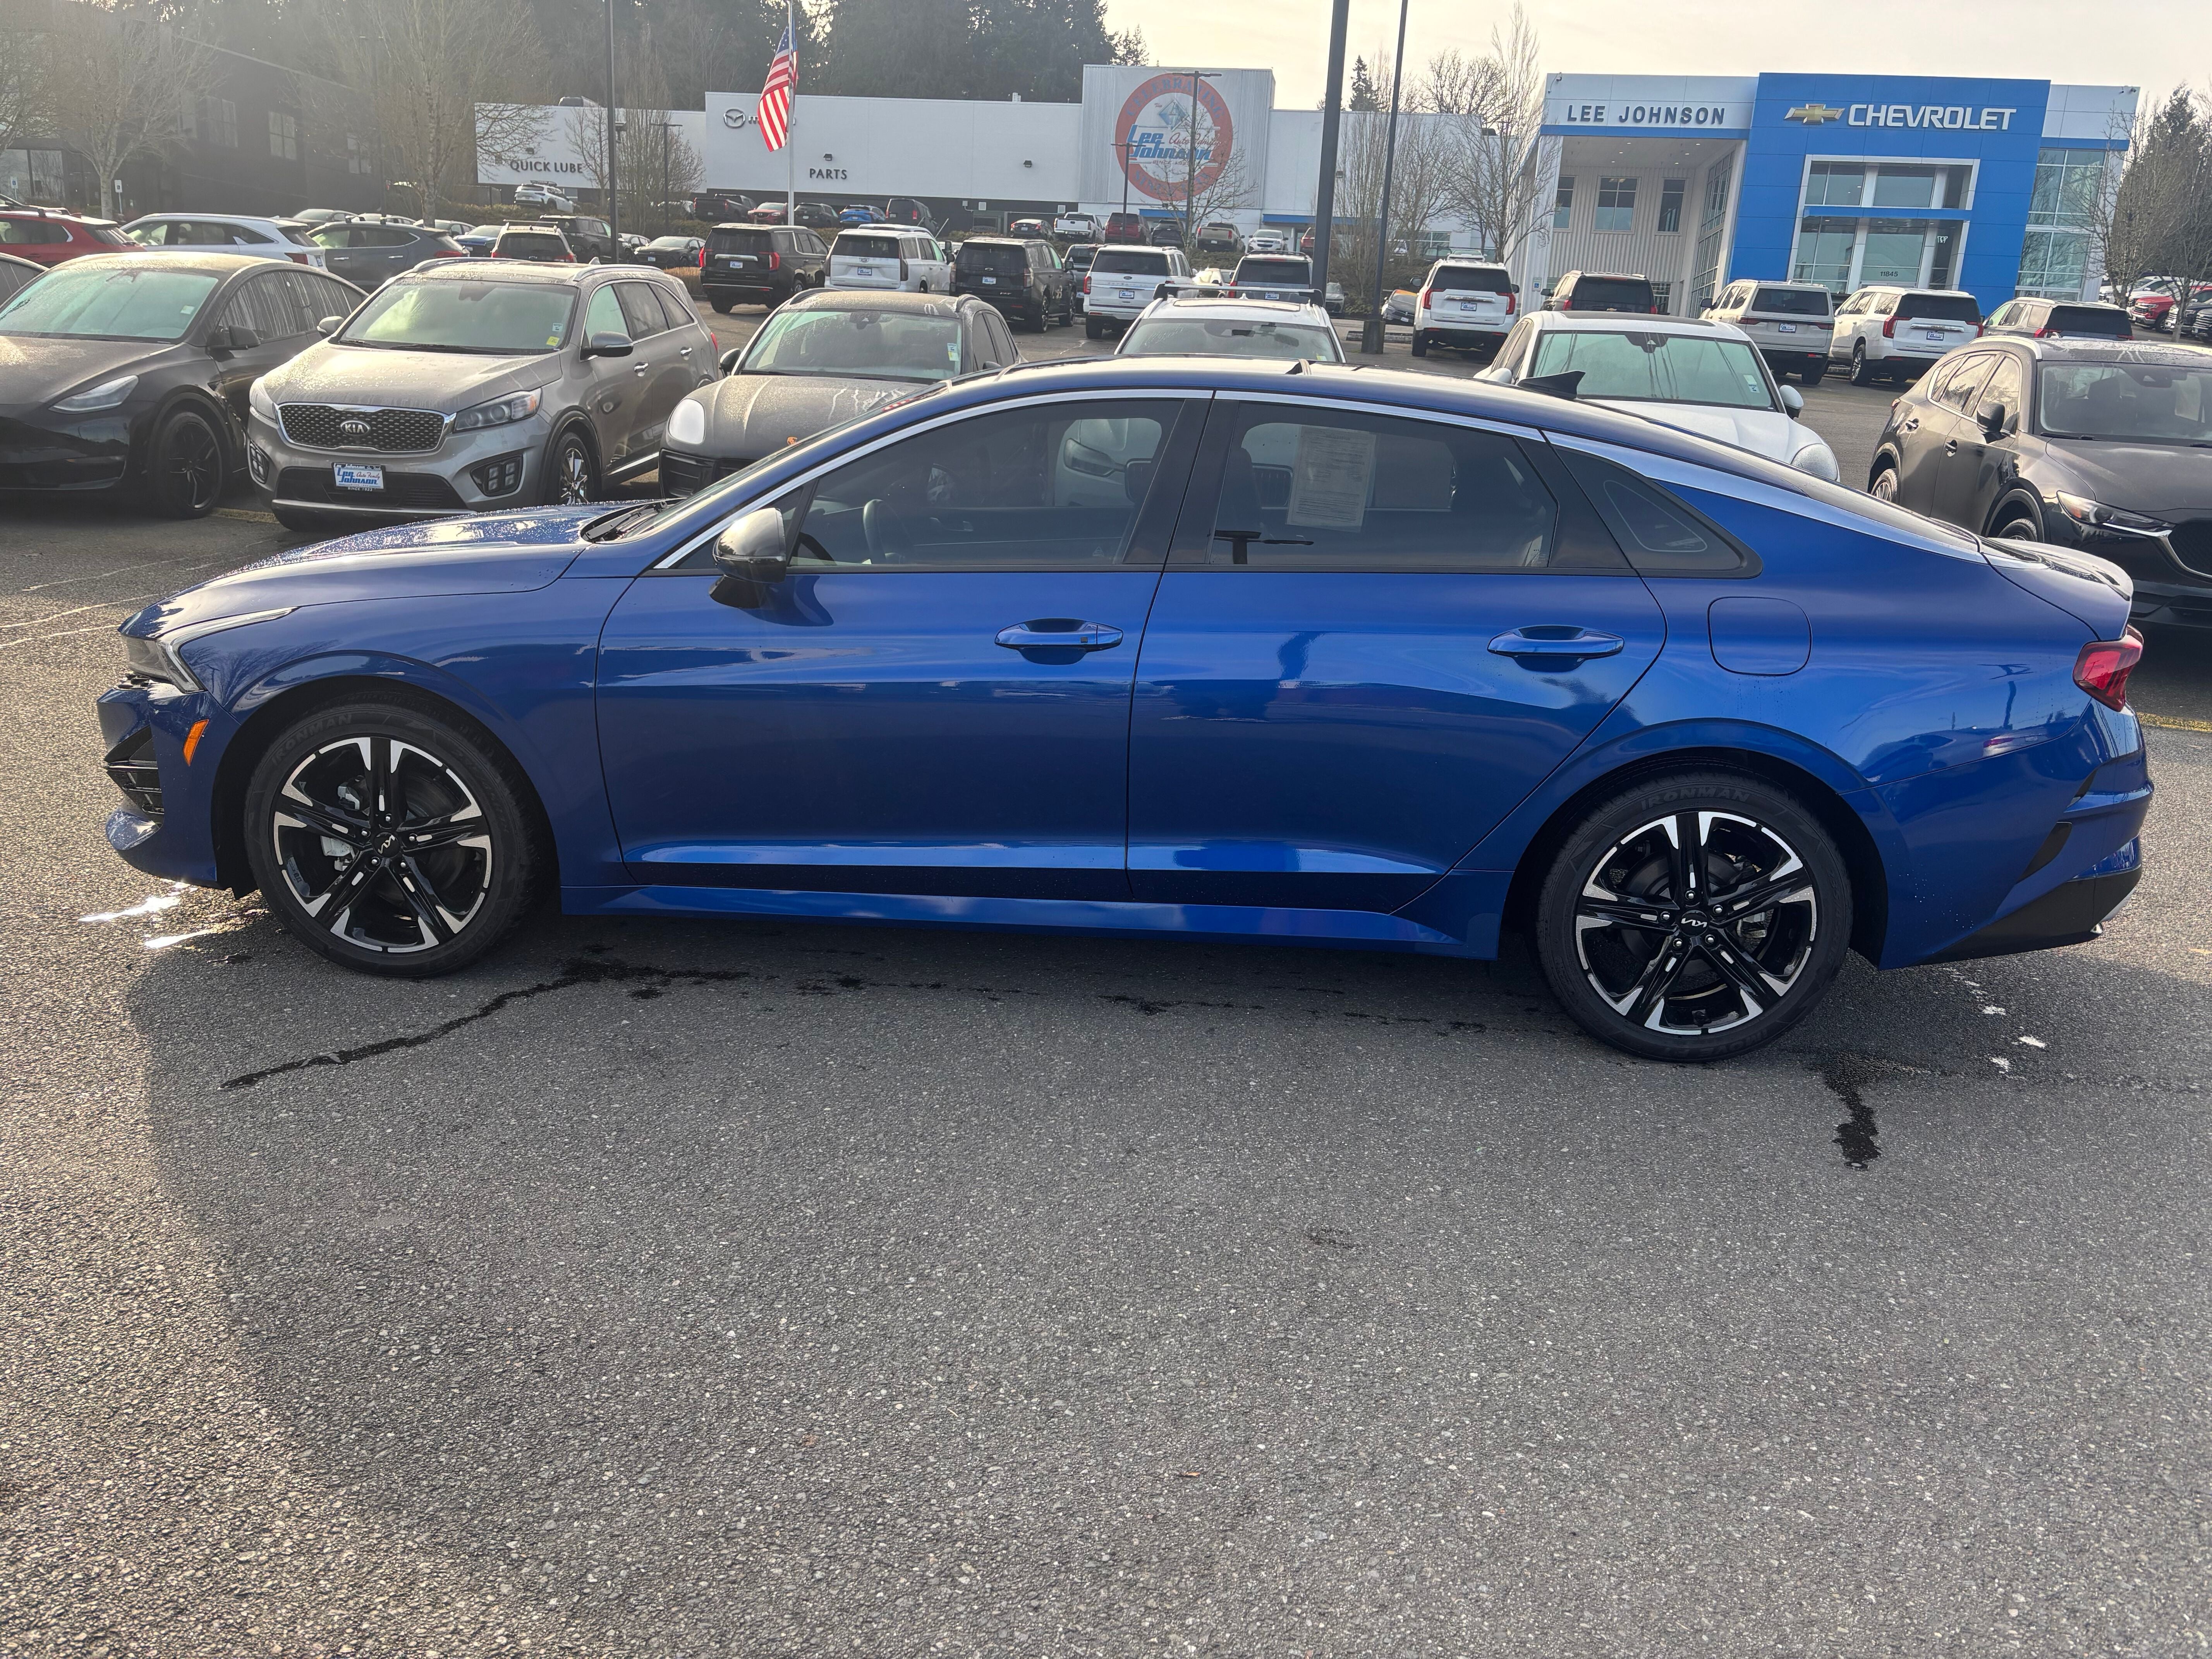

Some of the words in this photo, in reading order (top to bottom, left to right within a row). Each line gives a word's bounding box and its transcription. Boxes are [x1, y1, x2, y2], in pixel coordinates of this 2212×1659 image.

[1567, 105, 1606, 122] LEE
[1619, 106, 1725, 124] JOHNSON
[1848, 104, 2017, 130] CHEVROLET
[1127, 125, 1164, 144] Lee
[510, 160, 551, 173] QUICK
[554, 162, 583, 173] LUBE
[809, 168, 847, 180] PARTS
[345, 424, 365, 433] KIA
[338, 474, 378, 484] Johnson
[367, 472, 380, 480] Family
[271, 713, 352, 765] IRONMAN
[1641, 786, 1750, 811] IRONMAN
